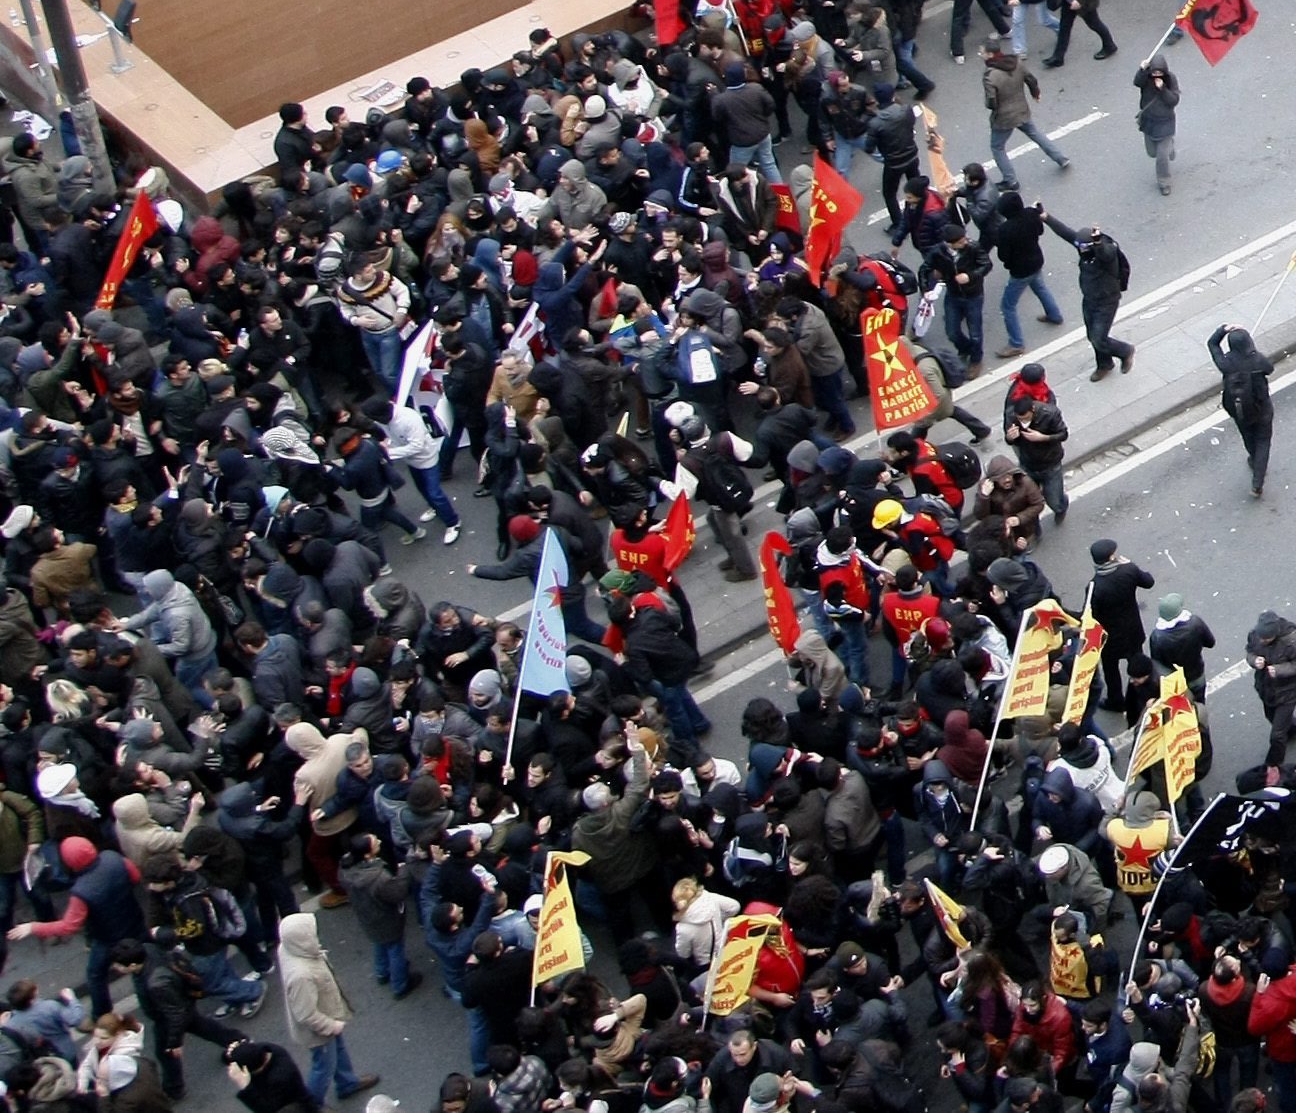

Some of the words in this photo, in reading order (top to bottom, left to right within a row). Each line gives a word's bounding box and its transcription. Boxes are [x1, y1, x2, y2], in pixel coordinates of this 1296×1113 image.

[865, 308, 895, 336] EHP
[619, 549, 649, 565] EHP
[894, 607, 924, 622] EHP
